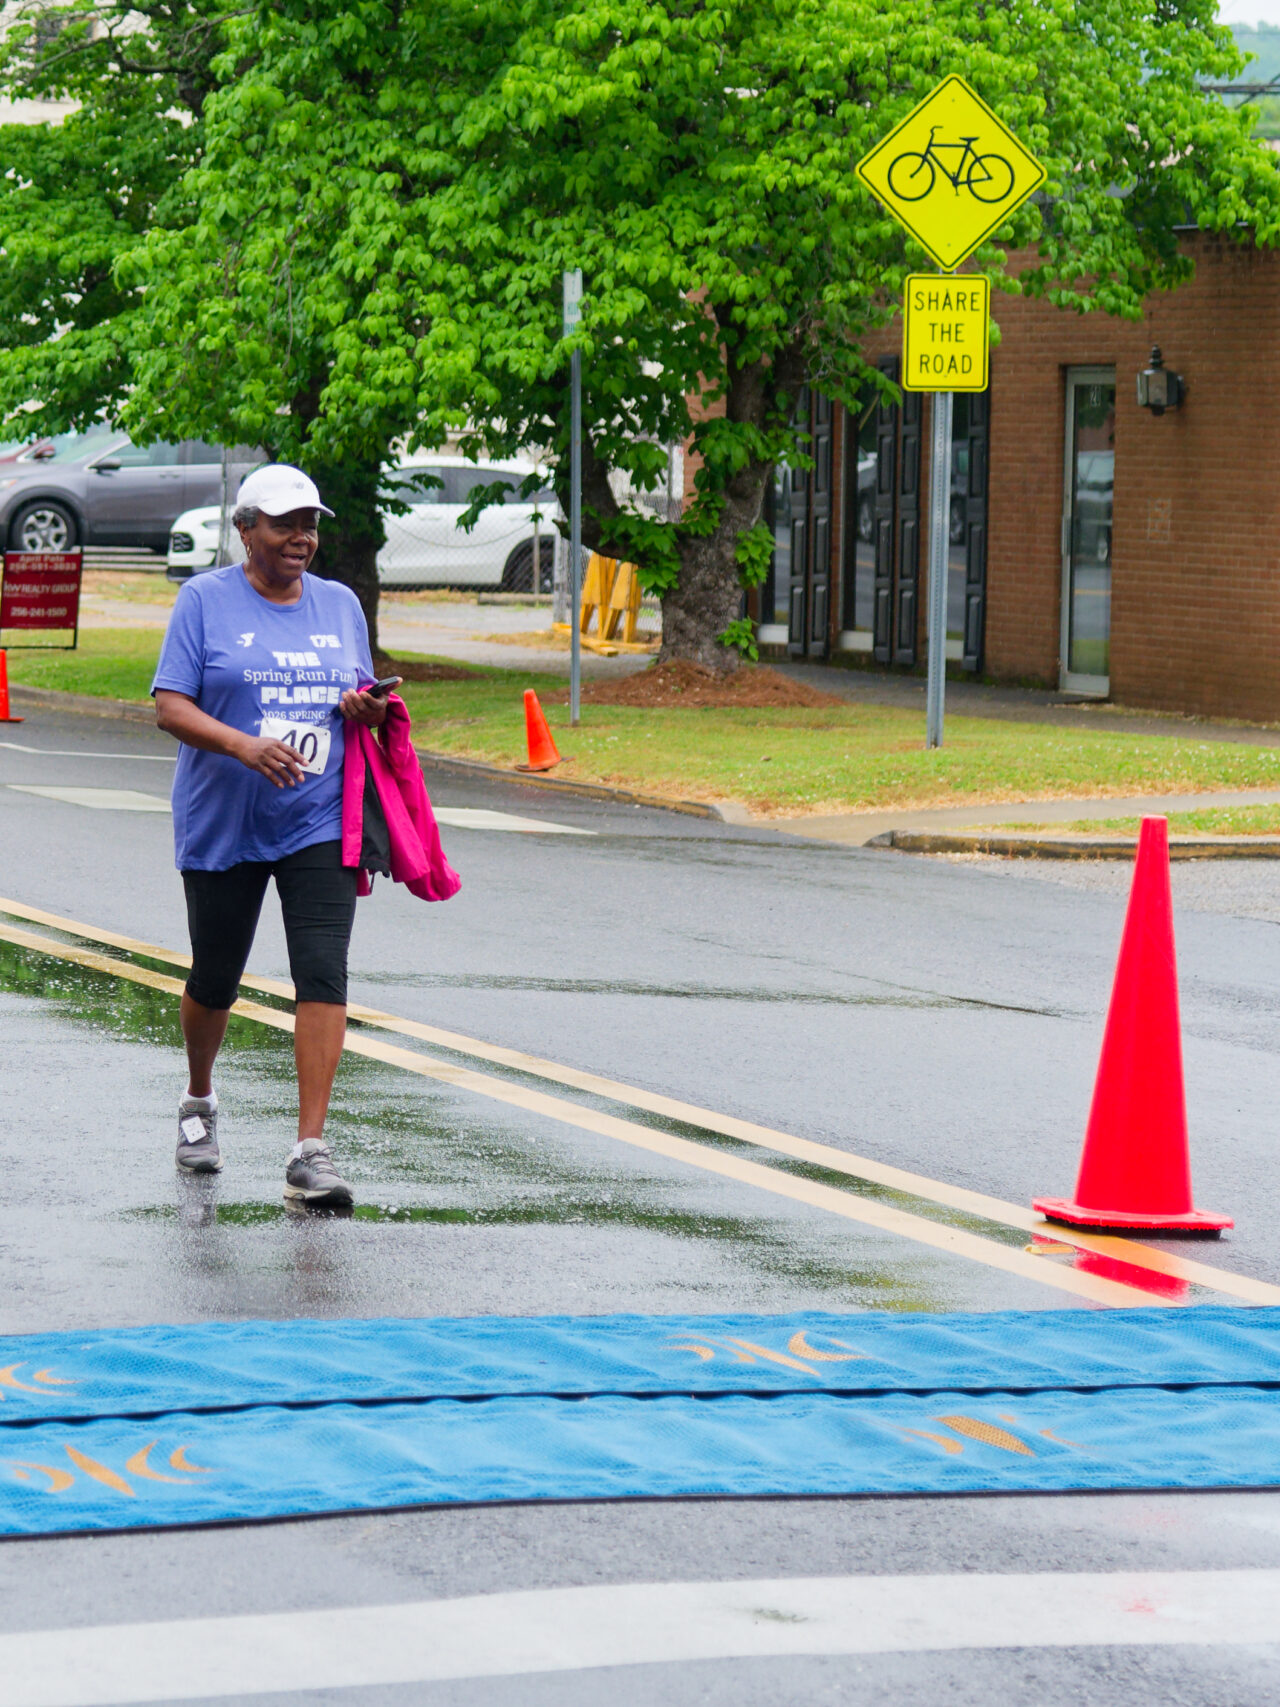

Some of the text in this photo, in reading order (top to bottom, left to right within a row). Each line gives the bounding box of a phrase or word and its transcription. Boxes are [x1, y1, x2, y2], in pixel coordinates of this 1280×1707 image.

[914, 291, 980, 311] SHARE
[929, 323, 965, 342] THE
[920, 354, 972, 374] ROAD
[22, 583, 51, 593] REALTY
[52, 583, 77, 594] GROUP
[272, 651, 321, 667] THE
[243, 668, 292, 685] Spring
[296, 669, 326, 682] Run
[261, 686, 340, 704] PLACE
[288, 710, 326, 720] SPRING
